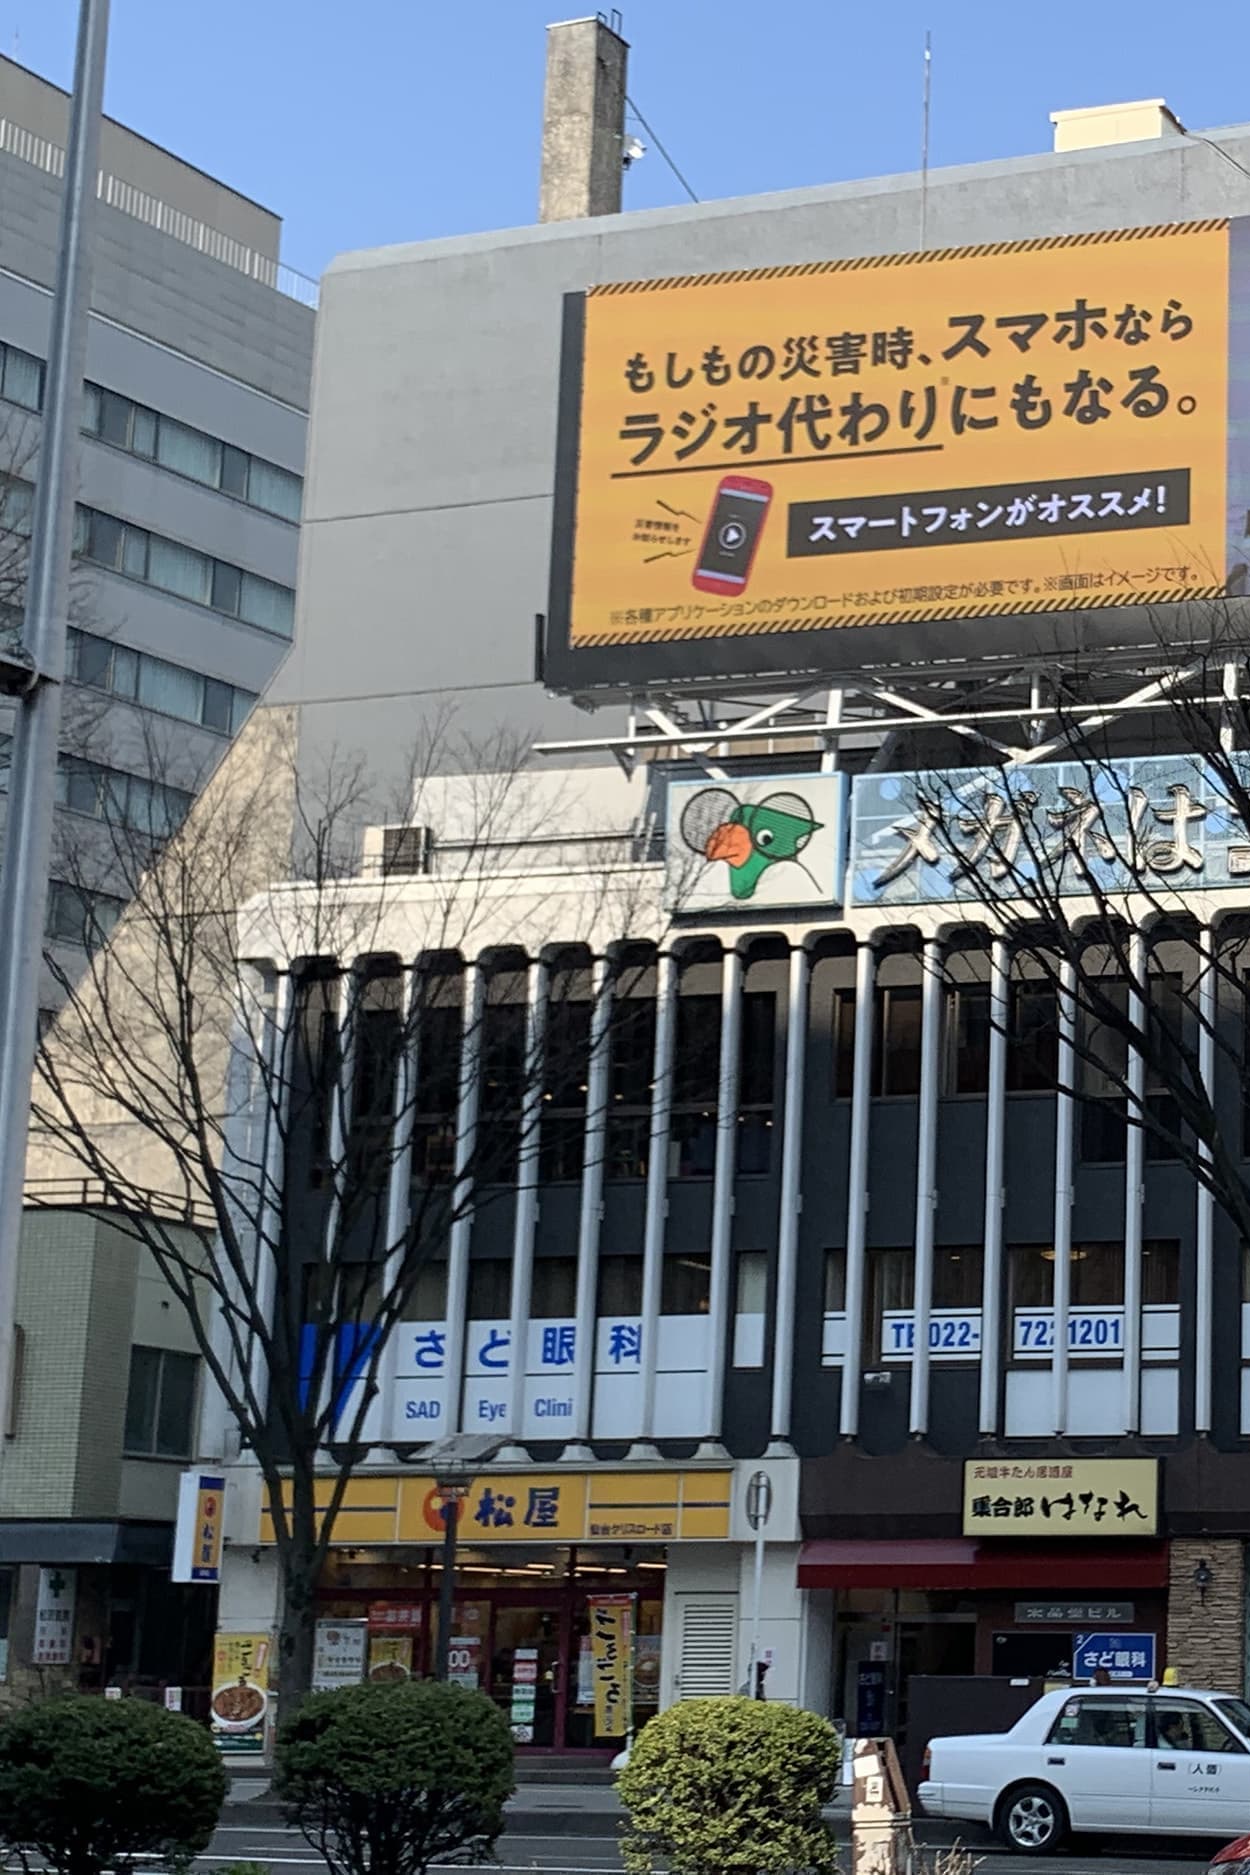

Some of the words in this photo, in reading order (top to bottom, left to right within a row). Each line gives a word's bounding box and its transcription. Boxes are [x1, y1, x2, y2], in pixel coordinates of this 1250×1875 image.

[624, 298, 1194, 394] もしもの災害時、スマホなら
[808, 485, 1167, 544] スマートフォンがオススメ!
[414, 1324, 642, 1368] さど眼科
[891, 1320, 980, 1349] TE022-
[405, 1401, 441, 1419] SAD
[477, 1400, 506, 1421] Eye
[534, 1397, 573, 1418] Clini
[474, 1486, 560, 1528] 松屋
[1083, 1650, 1147, 1668] さど眼科
